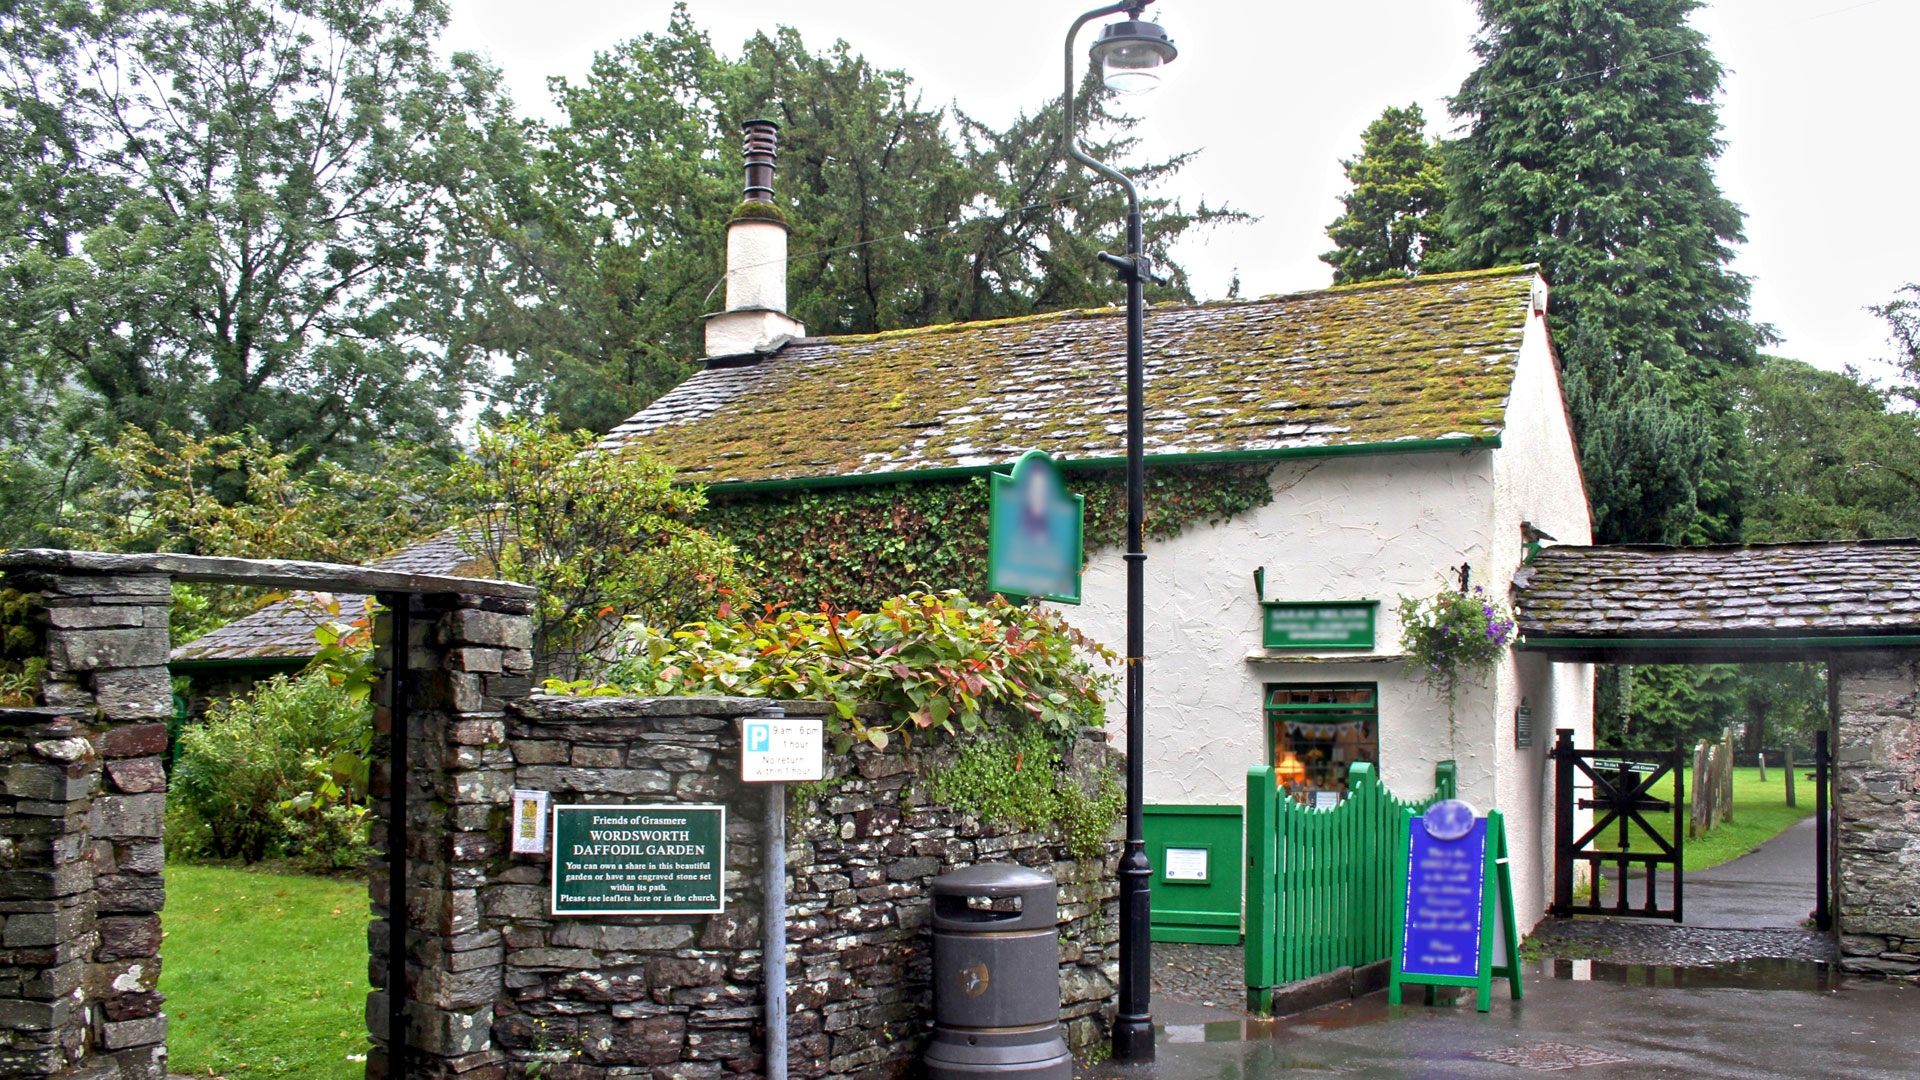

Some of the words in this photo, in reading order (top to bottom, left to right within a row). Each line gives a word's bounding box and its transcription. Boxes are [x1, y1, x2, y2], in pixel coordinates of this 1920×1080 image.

[752, 726, 767, 750] P
[789, 740, 809, 748] hour
[762, 756, 775, 764] No
[755, 767, 783, 776] within
[792, 767, 811, 775] hour
[593, 816, 628, 825] Friends
[630, 816, 640, 825] of
[641, 816, 687, 825] Grasmere
[590, 831, 690, 841] WORDSWORTH
[573, 845, 644, 855] DAFFODIL
[646, 845, 705, 855] GARDEN
[566, 862, 582, 870] You
[625, 862, 647, 870] share
[648, 862, 657, 870] in
[659, 862, 673, 870] this
[675, 862, 711, 870] beautiful
[565, 873, 593, 882] garden
[605, 873, 624, 881] have
[637, 873, 674, 882] engraved
[648, 884, 668, 893] path.
[560, 894, 586, 902] Please
[602, 894, 632, 902] leaflets
[633, 894, 651, 902] here
[664, 894, 672, 902] in
[674, 894, 687, 902] the
[688, 894, 717, 902] church.
